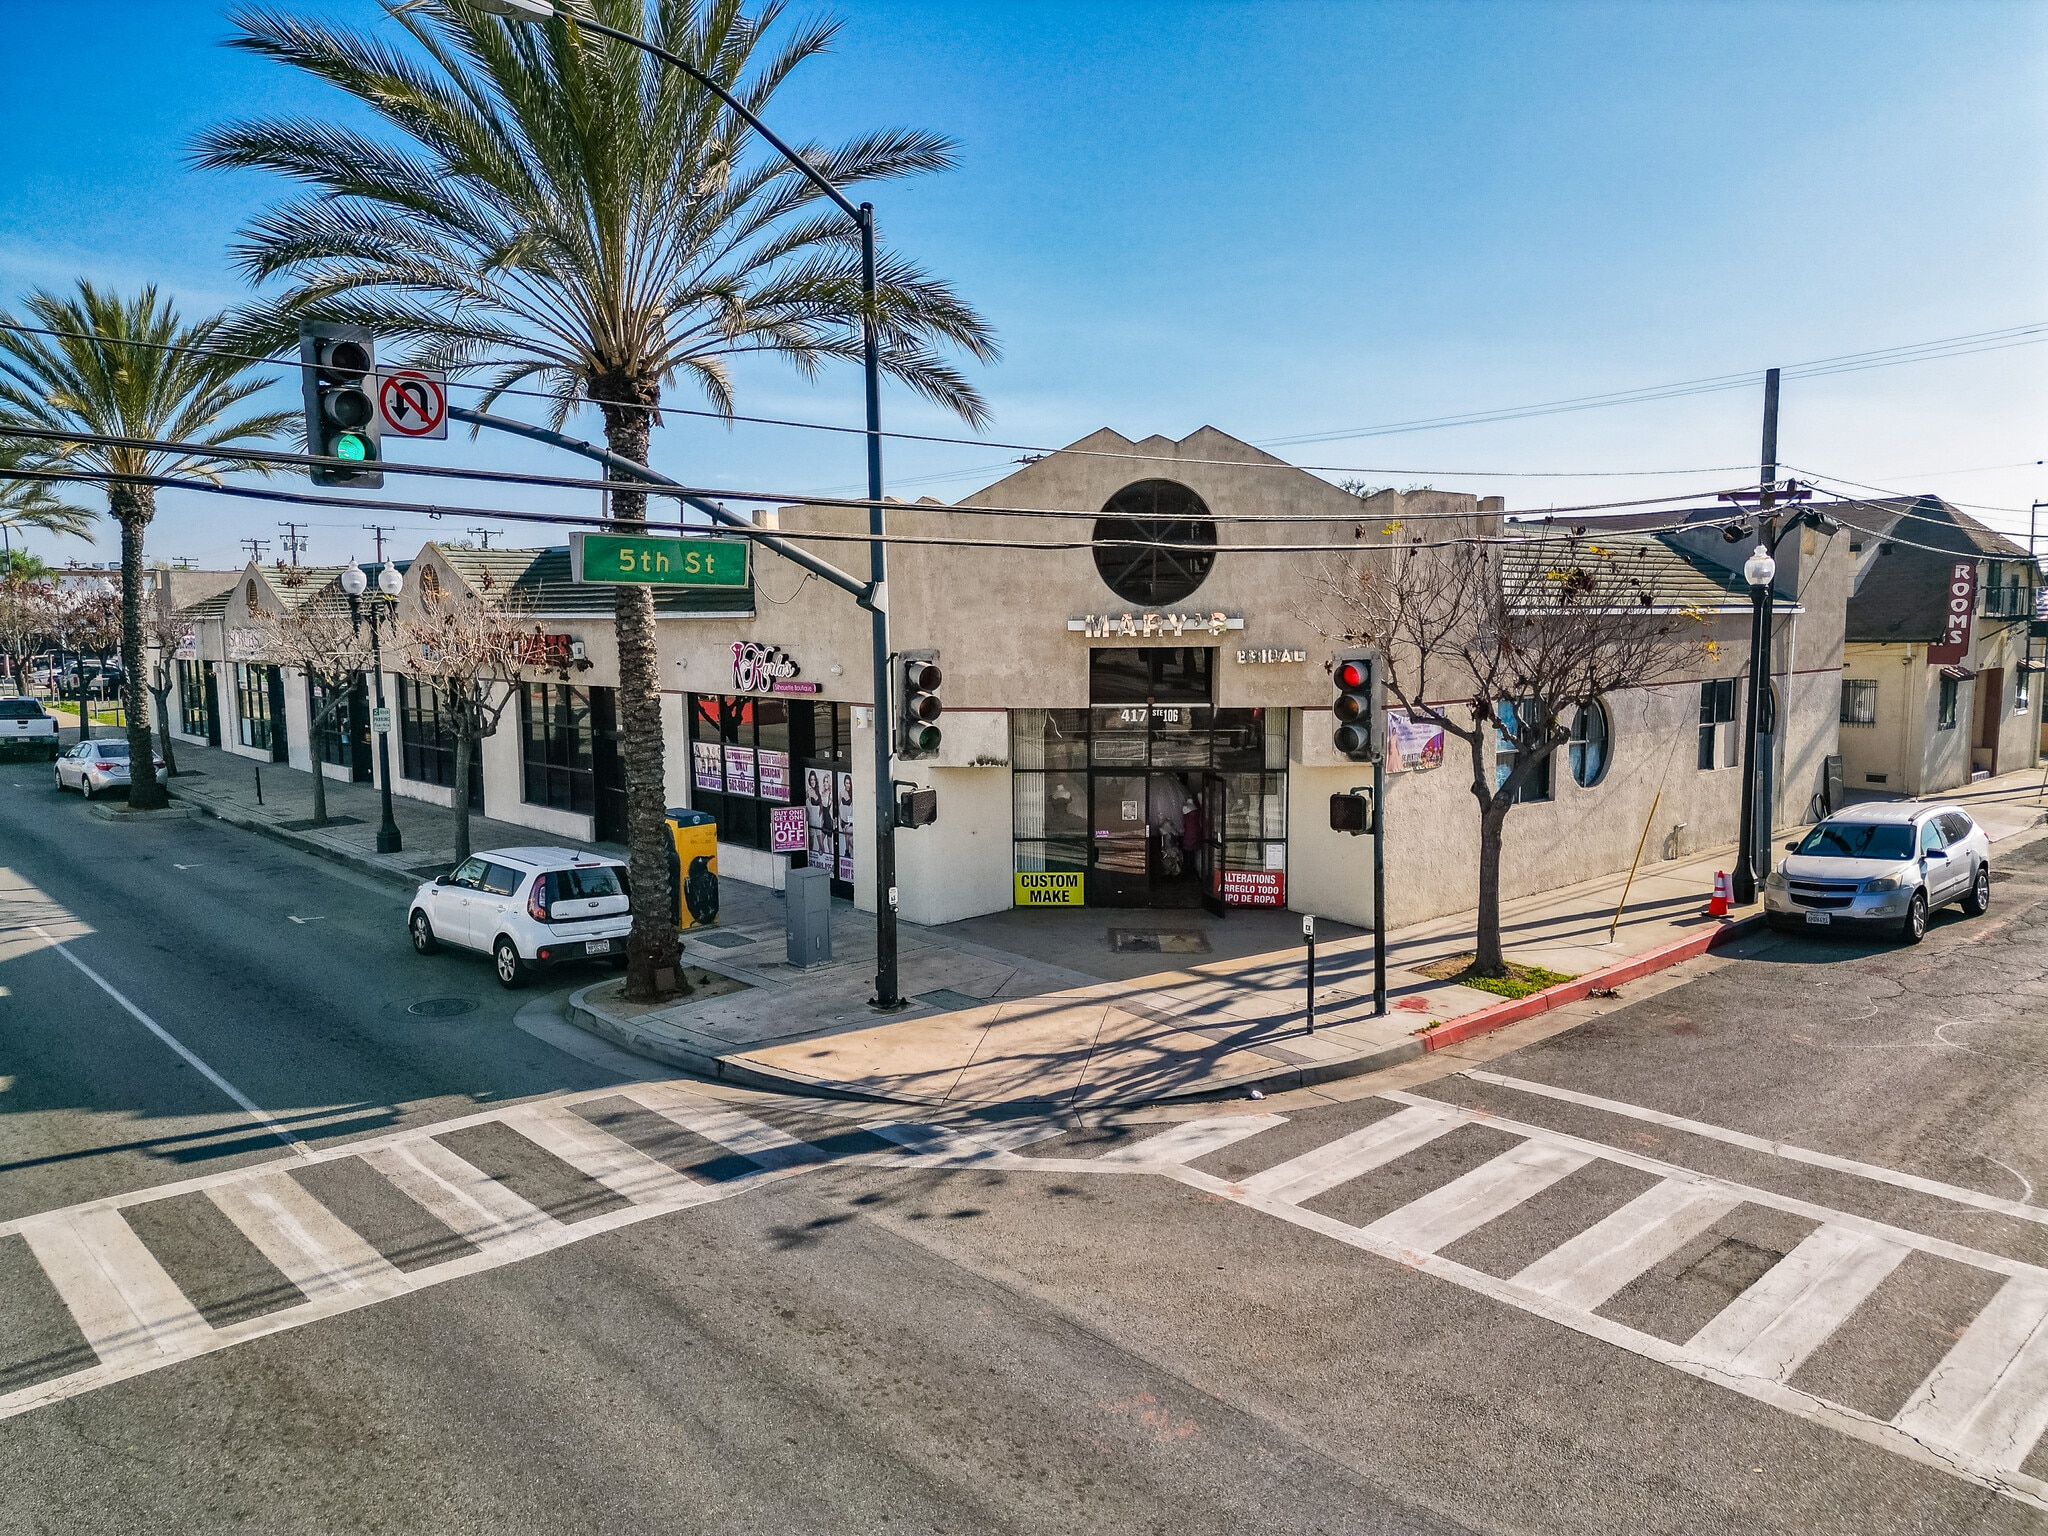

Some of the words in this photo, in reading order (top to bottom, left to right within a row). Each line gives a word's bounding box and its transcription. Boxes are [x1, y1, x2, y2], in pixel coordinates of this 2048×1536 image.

[619, 548, 669, 573] 5th
[685, 551, 715, 574] St
[1948, 564, 1970, 644] ROOMS
[1084, 612, 1227, 638] MARY'S
[1121, 709, 1147, 722] 417
[1152, 709, 1163, 717] STE
[1163, 709, 1178, 722] 106
[760, 767, 781, 779] MEXICAN
[774, 821, 804, 831] HALF
[775, 830, 804, 842] OFF
[1021, 874, 1078, 887] CUSTOM
[1257, 885, 1279, 894] TODO
[1030, 890, 1070, 903] MAKE
[1225, 894, 1239, 902] IPO
[1241, 894, 1252, 902] DE
[1254, 895, 1276, 904] ROPA
